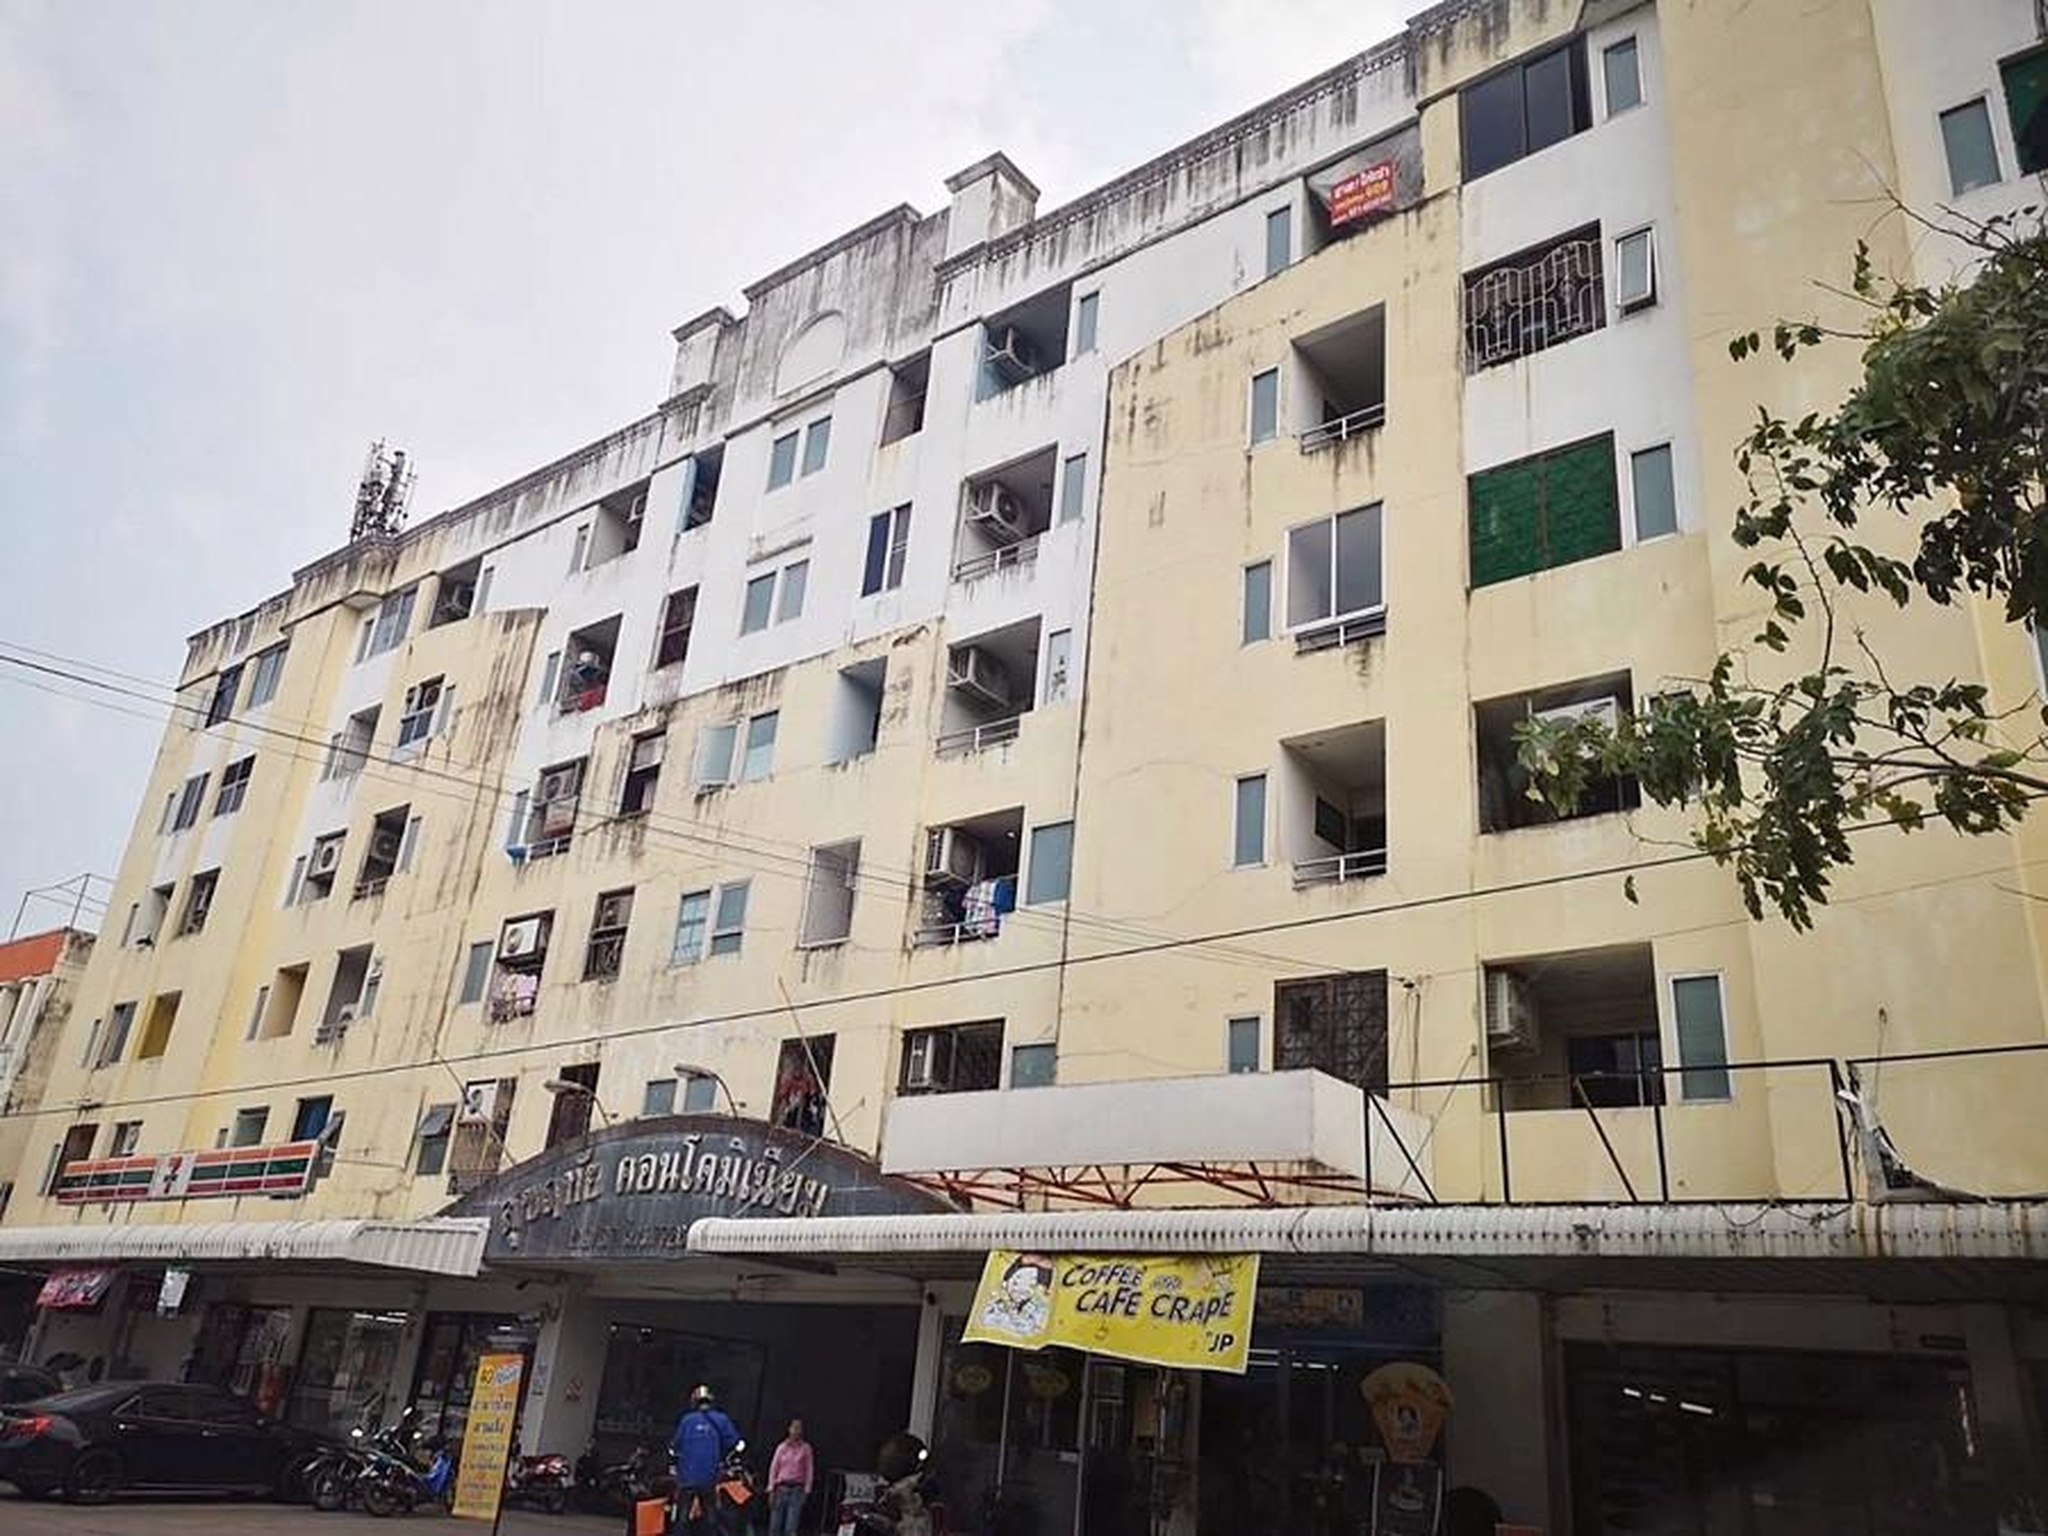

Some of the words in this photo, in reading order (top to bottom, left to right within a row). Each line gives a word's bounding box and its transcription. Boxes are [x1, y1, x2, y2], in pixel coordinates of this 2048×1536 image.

[1062, 1264, 1144, 1287] COFFEE
[1075, 1287, 1143, 1316] CAFE
[1151, 1292, 1235, 1325] CRAPE
